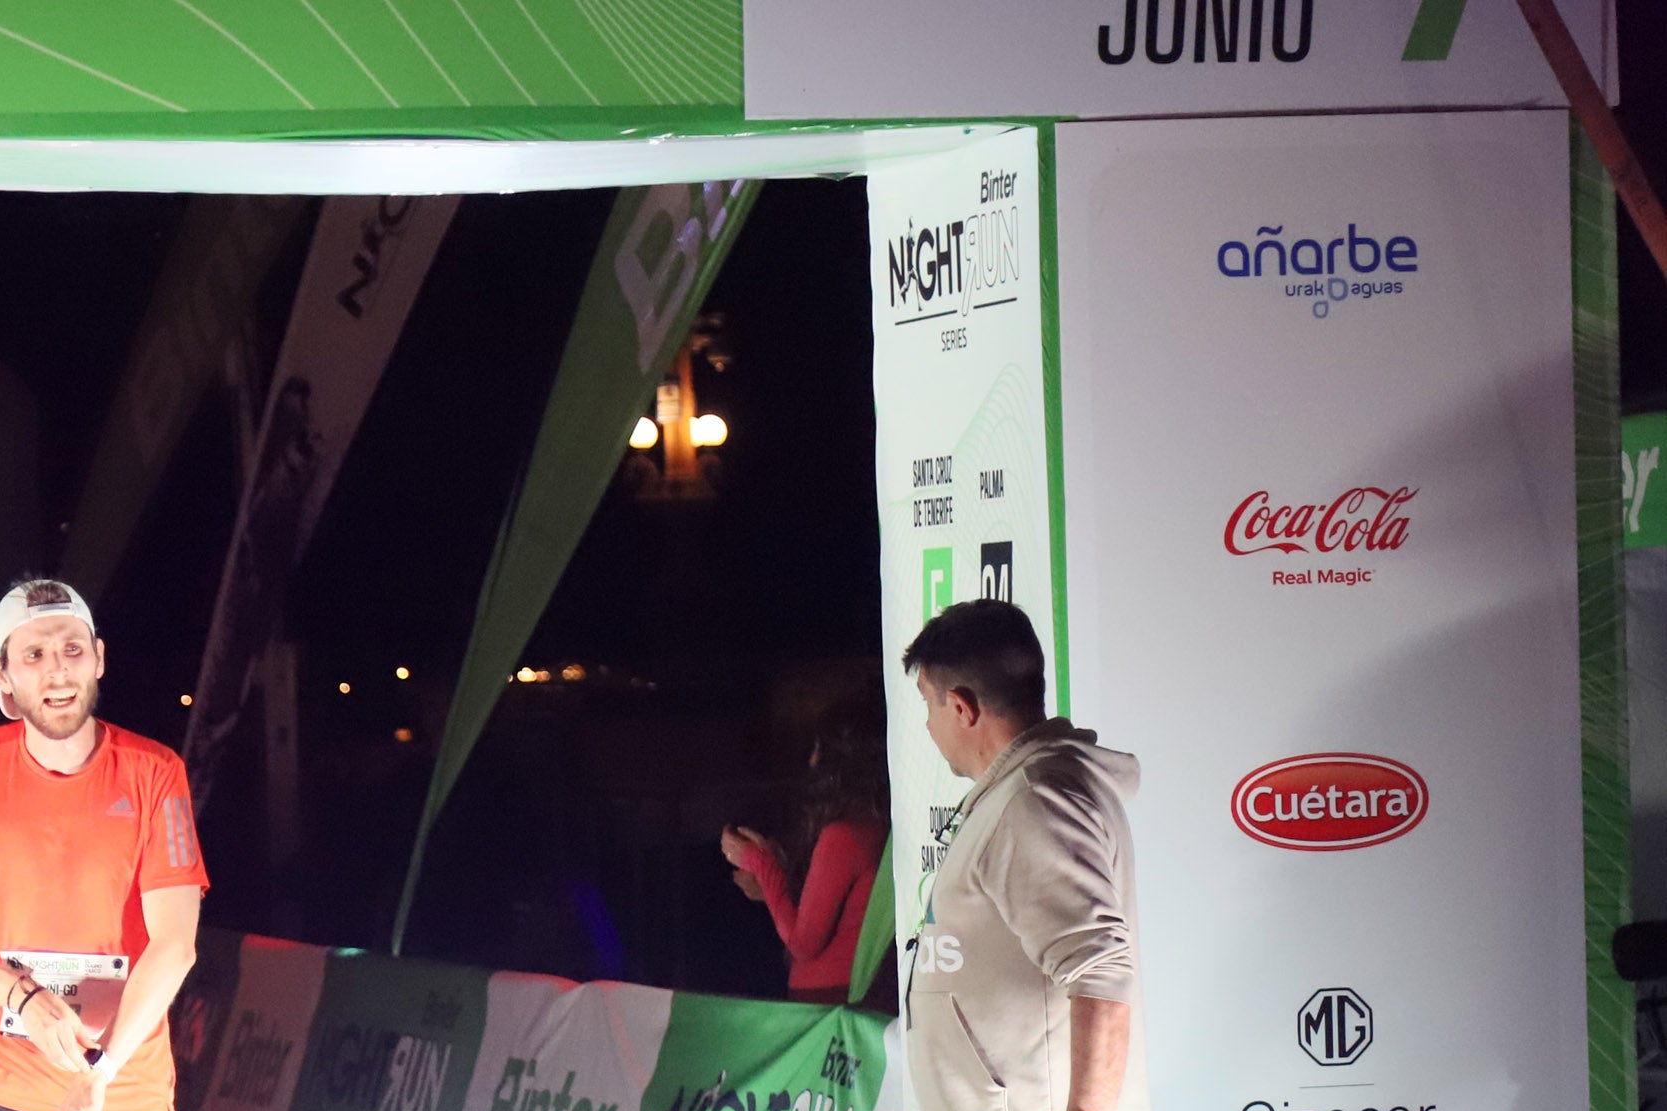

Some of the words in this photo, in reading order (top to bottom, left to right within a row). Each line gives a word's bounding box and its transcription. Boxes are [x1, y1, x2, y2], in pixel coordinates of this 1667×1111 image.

[980, 168, 1018, 205] Binter
[1217, 223, 1419, 277] añarbe
[1285, 280, 1324, 297] urak
[1350, 281, 1404, 298] aguas
[940, 327, 968, 352] SERIES
[912, 458, 934, 488] SANTA
[935, 455, 953, 485] CRUZ
[979, 469, 1005, 500] PALMA
[913, 500, 923, 528] DE
[924, 496, 954, 527] TENERIFE
[1223, 486, 1421, 556] Coca-Cola
[1272, 569, 1313, 586] Real
[1317, 567, 1373, 586] Magic
[1246, 784, 1411, 823] Cuétara
[1304, 994, 1367, 1059] MG
